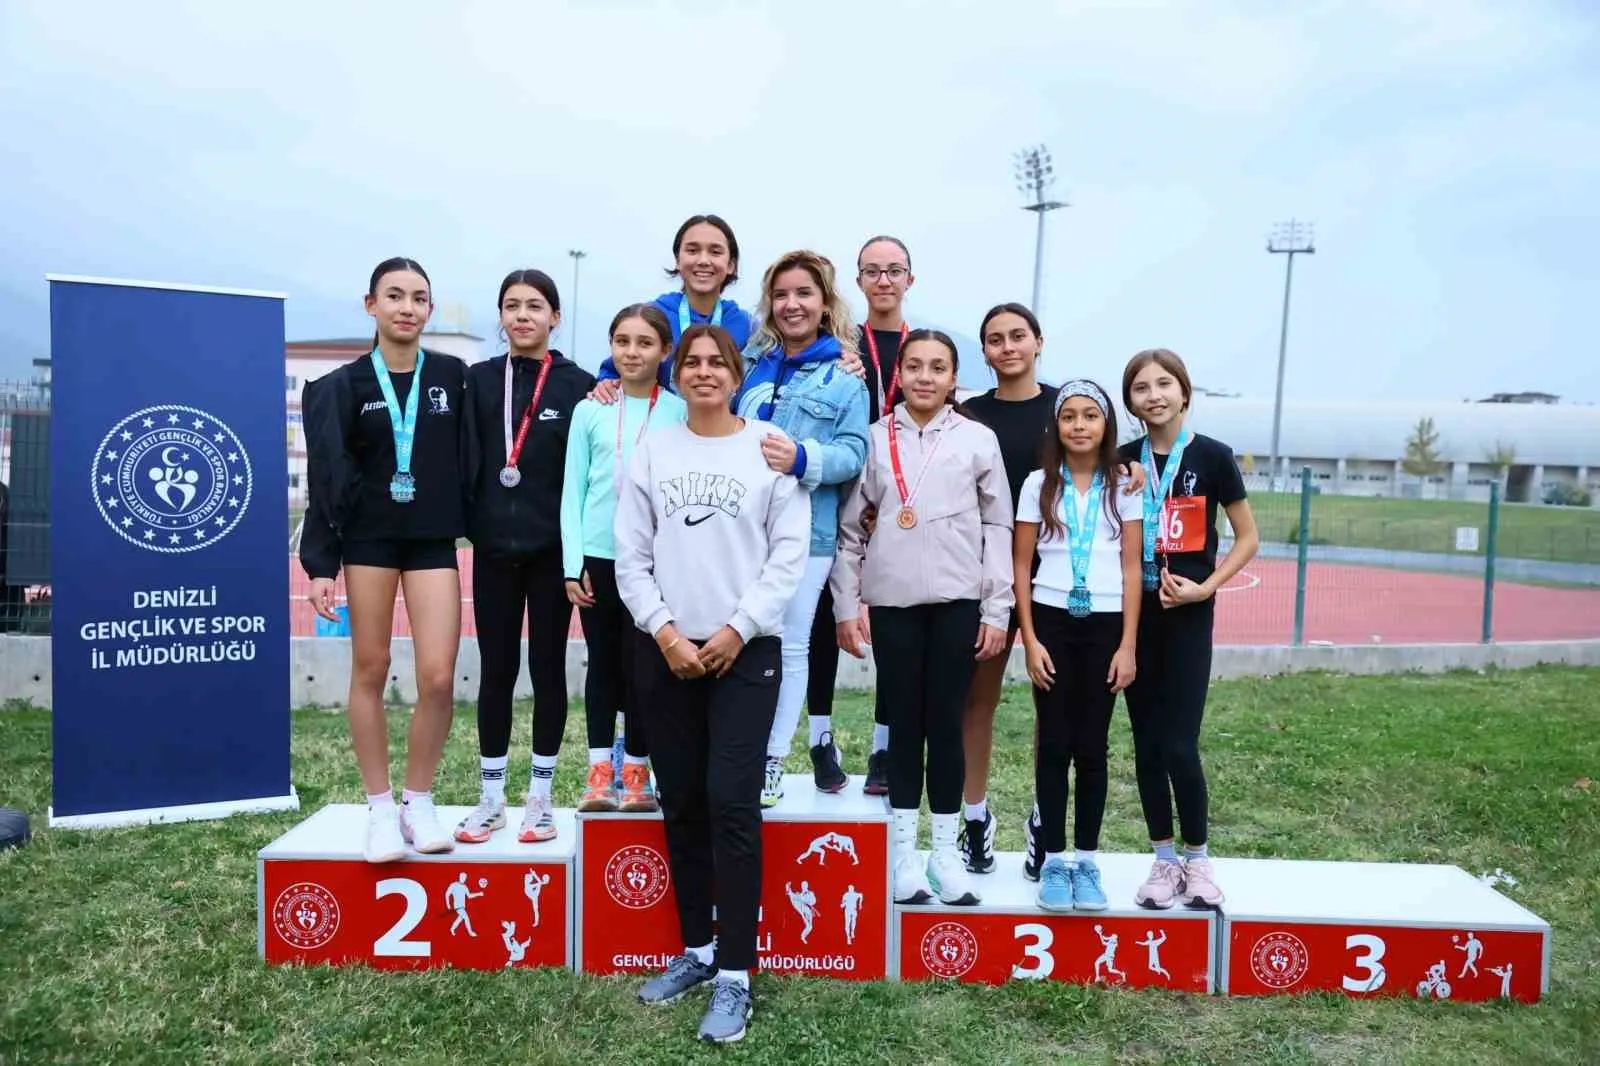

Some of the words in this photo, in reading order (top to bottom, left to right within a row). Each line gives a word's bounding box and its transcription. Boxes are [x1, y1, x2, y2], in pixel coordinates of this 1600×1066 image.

[123, 435, 157, 493] CUMHURİYETİ
[159, 431, 201, 448] GENÇLİK
[202, 443, 215, 457] VE
[211, 456, 225, 481] SPOR
[659, 472, 748, 518] NIKE
[134, 585, 217, 609] DENİZLİ
[80, 615, 176, 642] GENÇLİK
[179, 617, 206, 635] VE
[211, 615, 266, 634] SPOR
[91, 648, 111, 669] İL
[116, 640, 256, 667] MÜDÜRLÜĞÜ
[374, 877, 431, 957] 2
[612, 952, 676, 969] GENÇLİK
[758, 953, 855, 970] MÜDÜRLÜĞÜ
[1012, 923, 1055, 980] 3
[1342, 934, 1386, 992] 3
